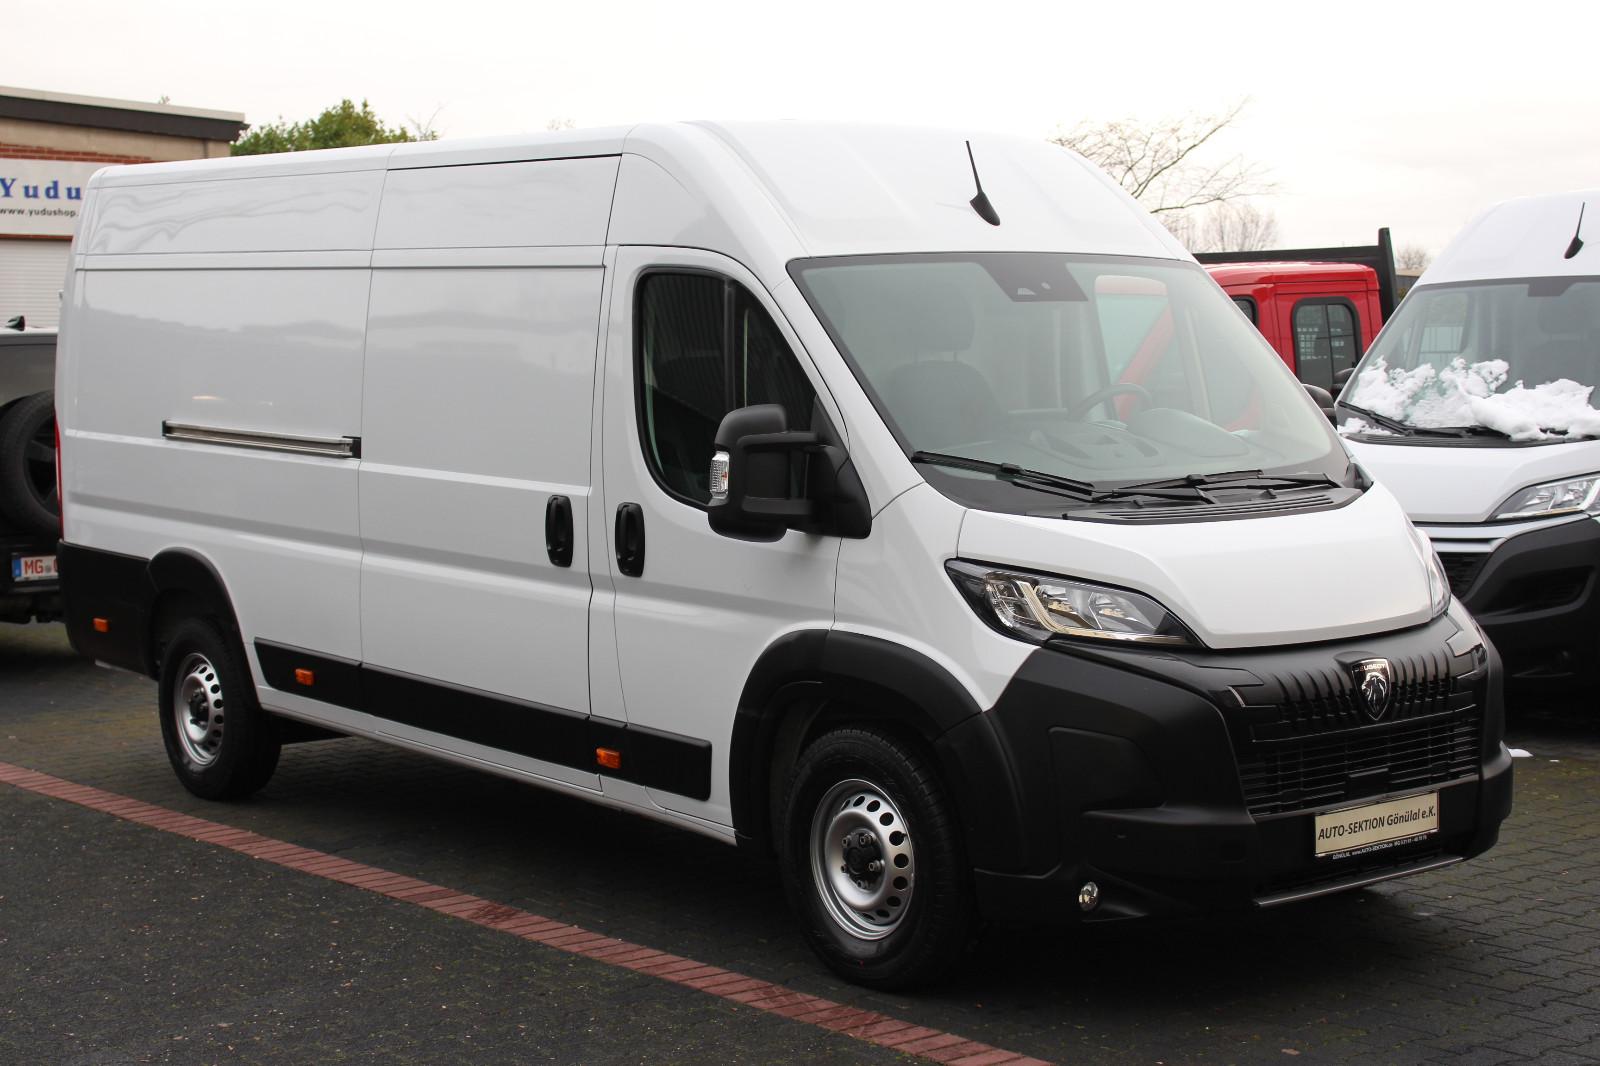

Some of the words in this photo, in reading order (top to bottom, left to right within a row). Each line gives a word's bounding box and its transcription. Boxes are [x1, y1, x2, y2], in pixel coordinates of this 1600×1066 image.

[0, 177, 82, 200] Yudu
[24, 559, 44, 575] MG
[1318, 816, 1385, 840] AUTO-SEKTION
[1386, 808, 1421, 826] Gönülal
[1421, 805, 1437, 819] e.K.
